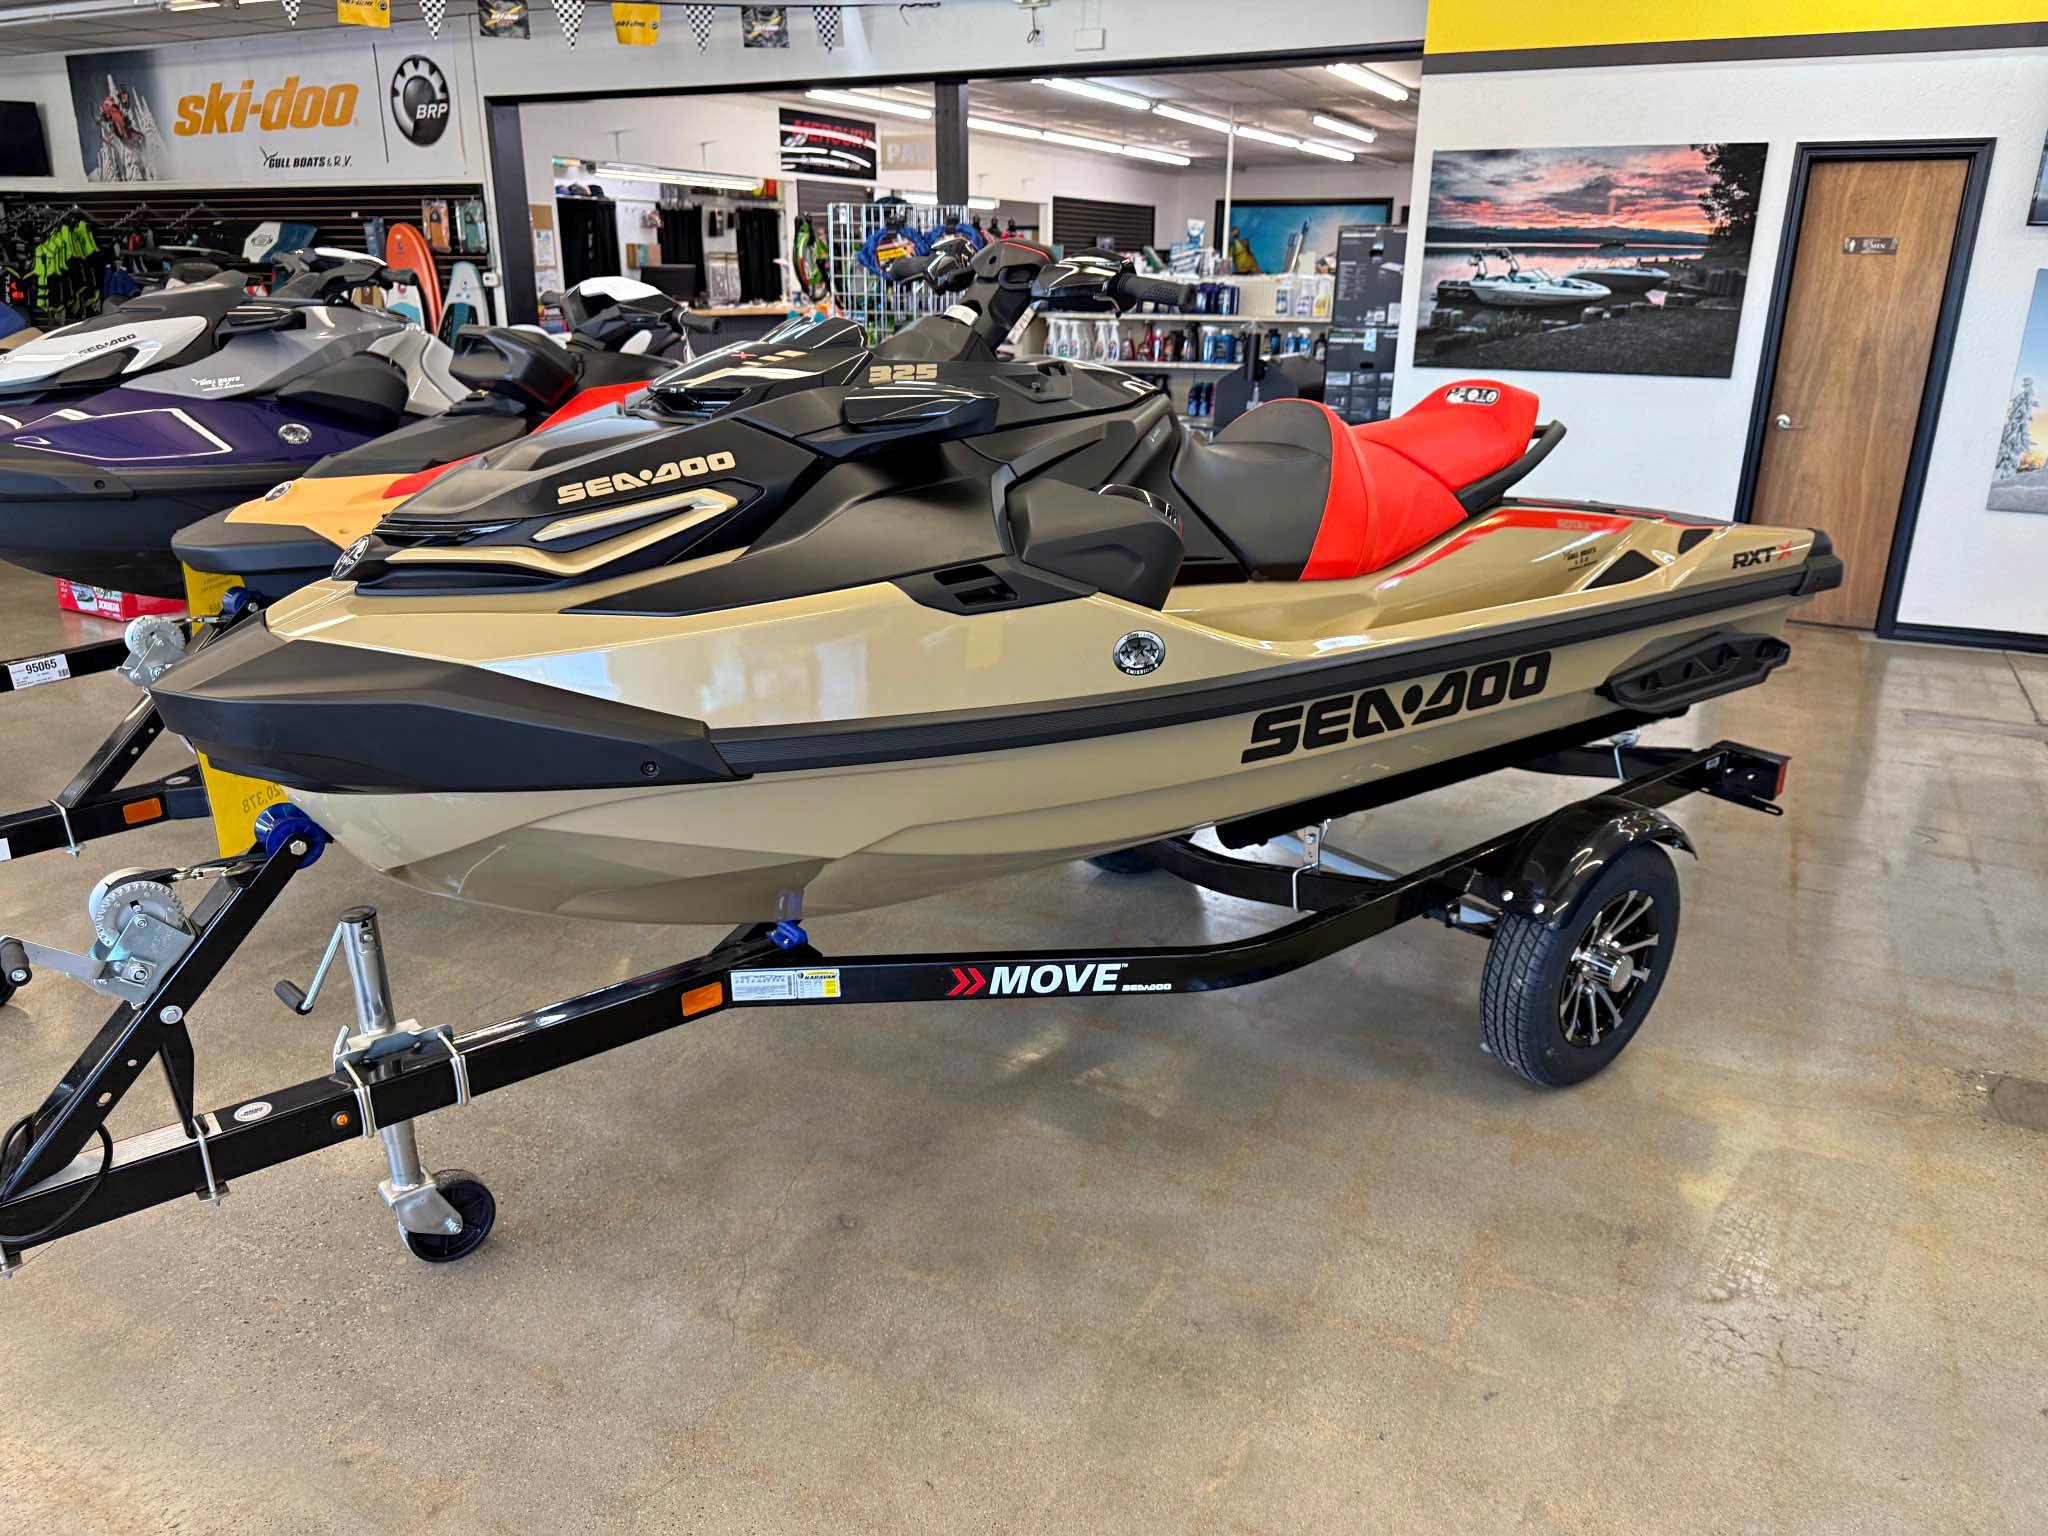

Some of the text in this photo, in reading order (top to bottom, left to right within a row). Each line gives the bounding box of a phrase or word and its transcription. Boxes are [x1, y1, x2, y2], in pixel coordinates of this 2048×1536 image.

[174, 76, 359, 136] ski-doo
[416, 102, 448, 120] BRP
[268, 157, 291, 169] GULL
[293, 155, 326, 168] BOATS
[868, 363, 938, 385] 325
[25, 658, 58, 675] 95065
[988, 963, 1122, 995] MOVE
